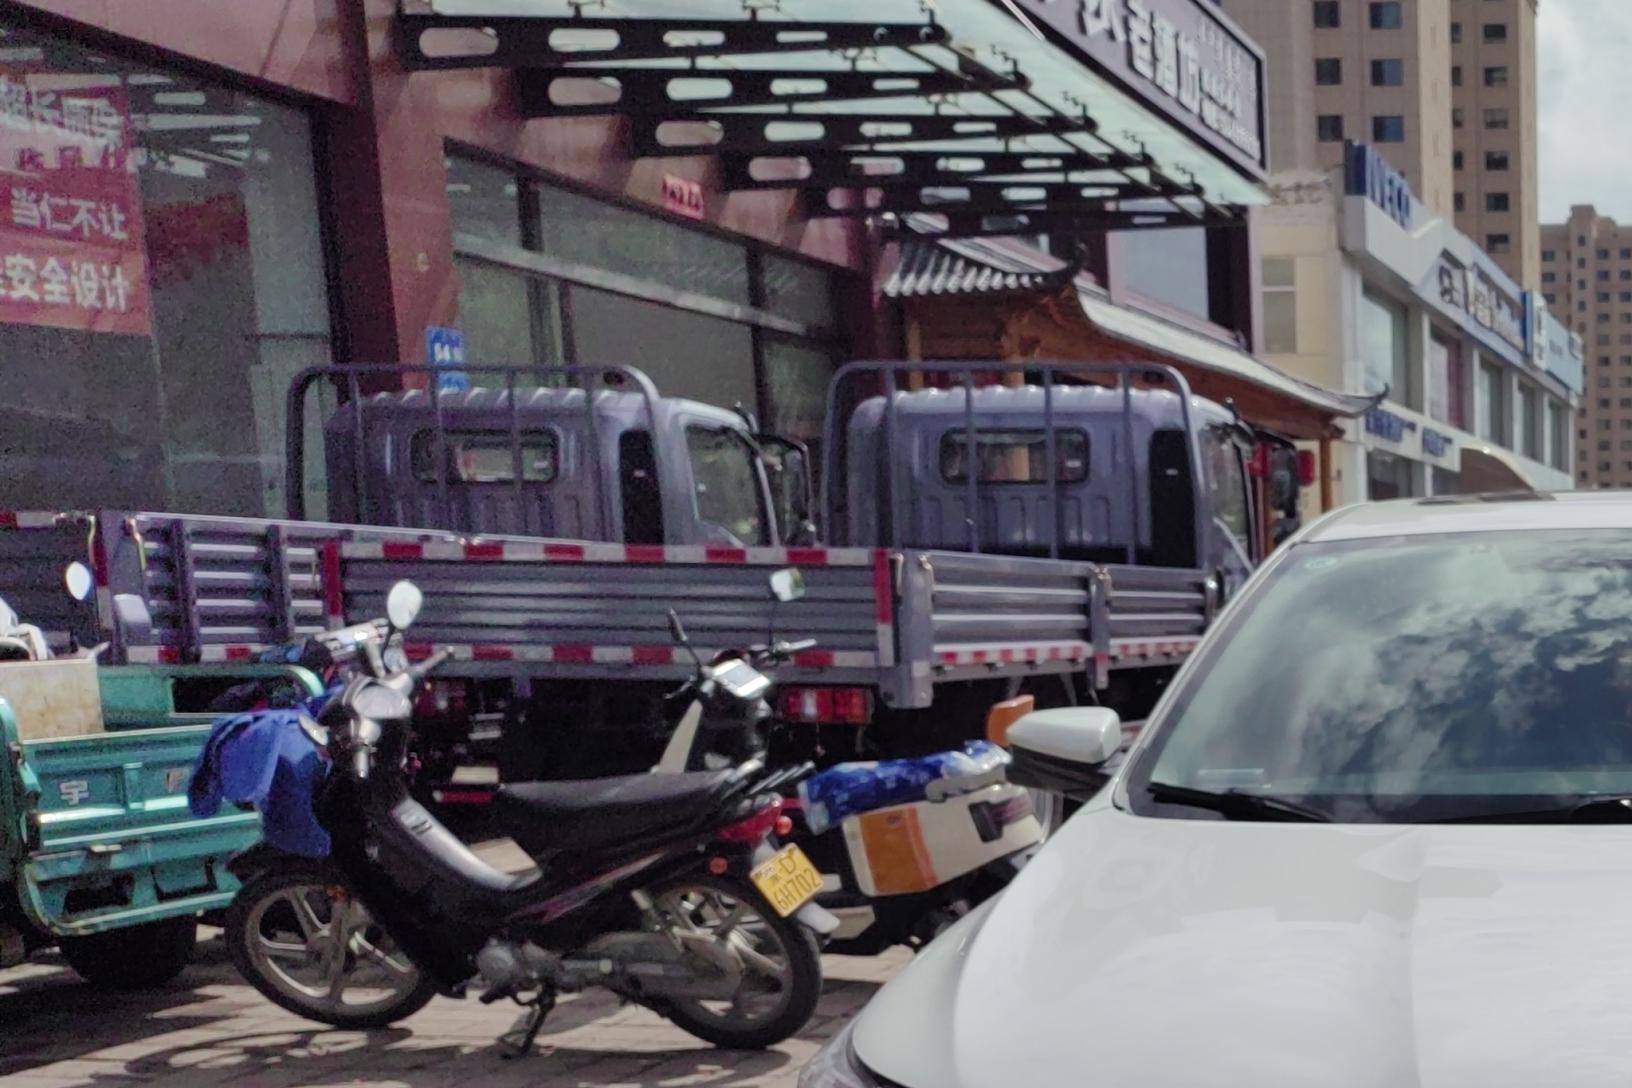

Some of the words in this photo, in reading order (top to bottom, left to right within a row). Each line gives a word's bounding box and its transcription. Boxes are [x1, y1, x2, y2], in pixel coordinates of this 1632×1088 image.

[10, 187, 127, 240] 当仁不让
[0, 254, 130, 312] 安全设计
[774, 868, 821, 911] 6H702
